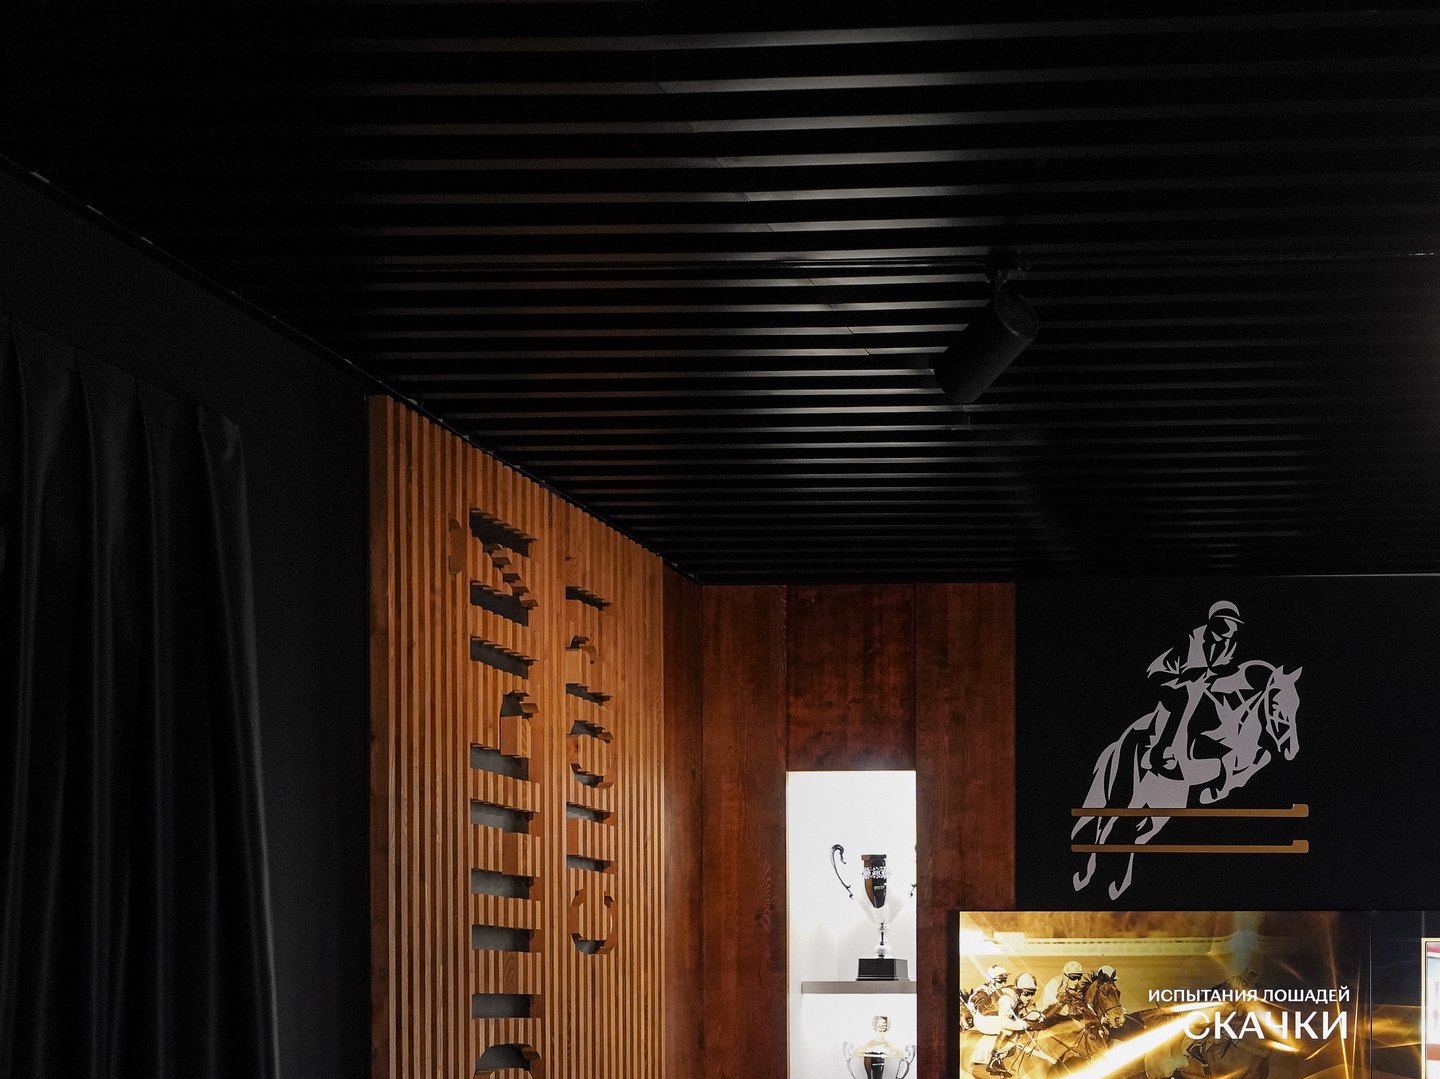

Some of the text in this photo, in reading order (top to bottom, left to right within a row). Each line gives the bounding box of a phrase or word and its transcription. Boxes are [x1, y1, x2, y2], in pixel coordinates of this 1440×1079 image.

[566, 556, 615, 955] СПОРТ
[1148, 985, 1350, 1004] ИСПЫТАНИЯ ЛОШАДЕЙ
[1183, 1011, 1348, 1040] СКАЧКИ
